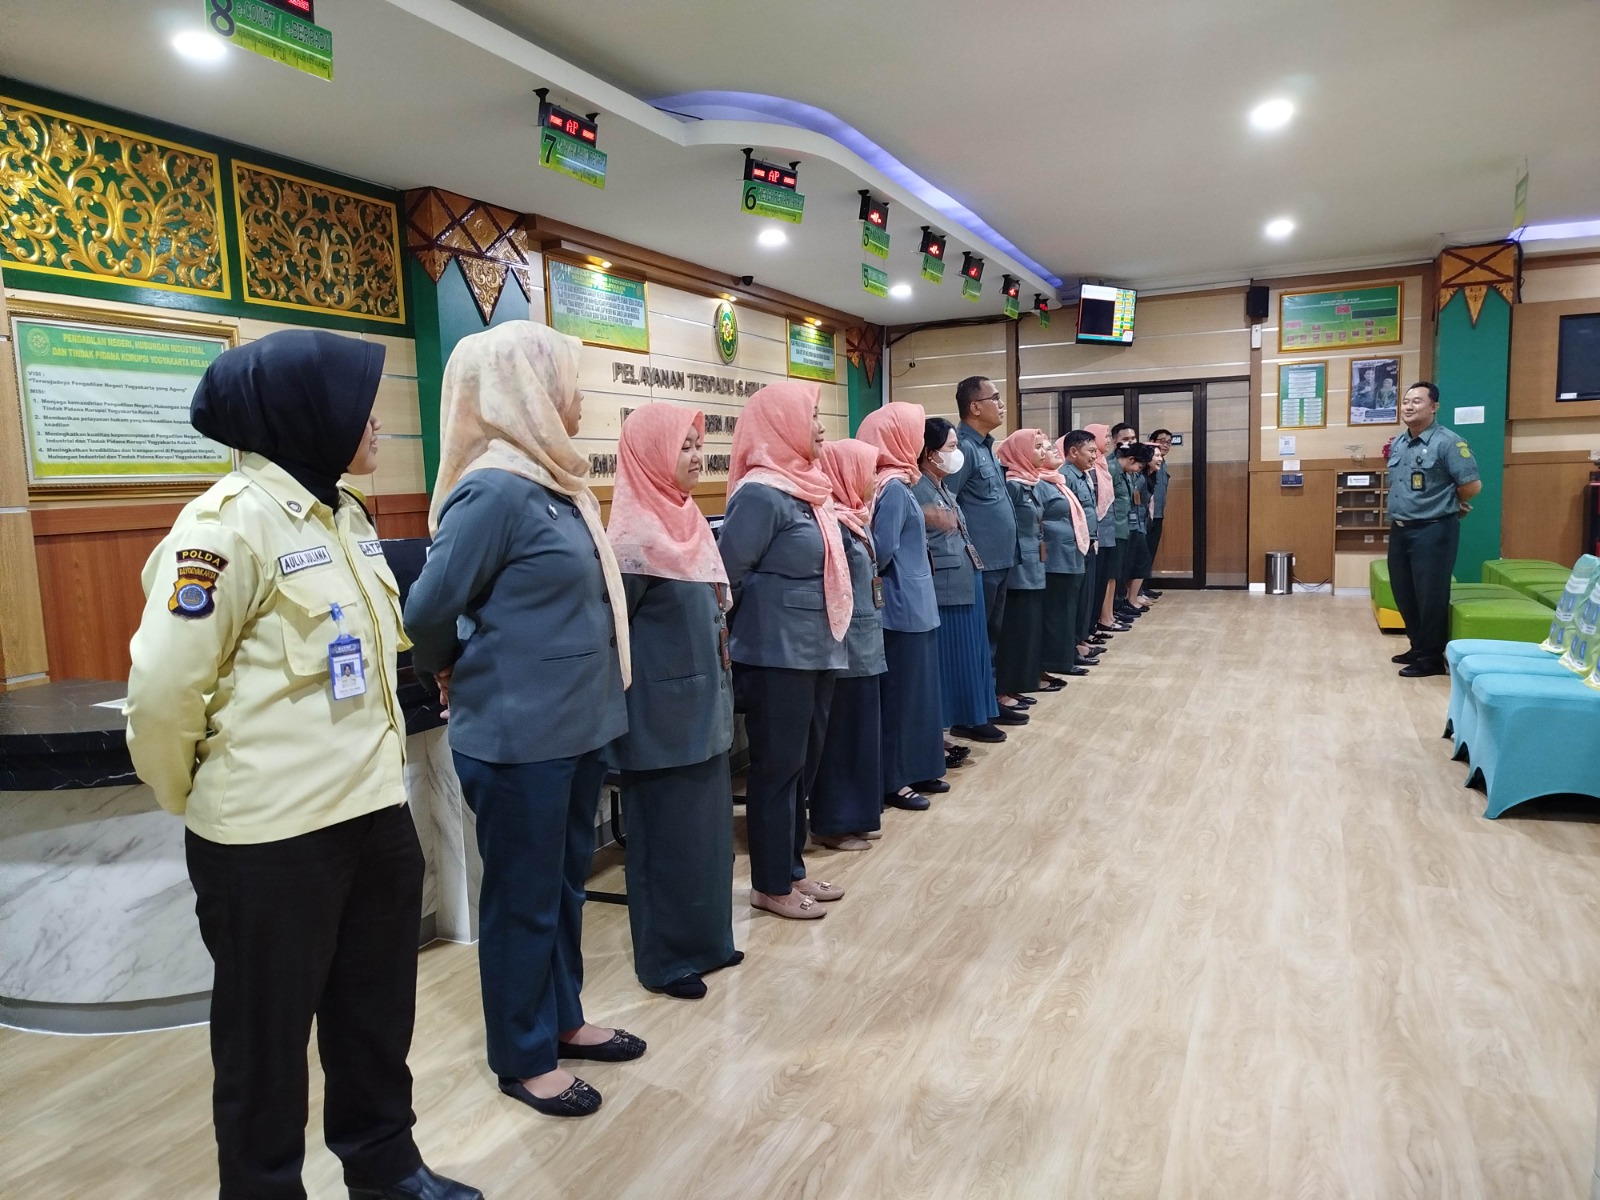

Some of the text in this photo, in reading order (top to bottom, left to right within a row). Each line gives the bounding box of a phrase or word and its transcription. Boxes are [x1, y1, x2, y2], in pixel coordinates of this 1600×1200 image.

[210, 0, 235, 37] 8
[237, 1, 276, 31] e-COURT
[544, 132, 557, 163] 7
[745, 186, 757, 210] 6
[863, 226, 870, 246] 5
[863, 267, 869, 288] 5
[63, 333, 206, 355] PENGADILAN NEGERI, HUBUNGAN INDUSTRIAL
[52, 347, 67, 357] DAN
[68, 348, 94, 359] TINDAK
[95, 350, 121, 361] PIDANA
[121, 352, 149, 363] KORUPSI
[149, 355, 190, 366] YOGYAKARTA
[190, 359, 209, 368] KELAS
[71, 380, 104, 388] Pengadilan
[612, 362, 685, 392] PELAYANAN
[687, 373, 735, 396] TERPADU
[182, 550, 221, 566] POLDA
[361, 542, 380, 554] SATP
[284, 550, 328, 571] AULIA JULIANA
